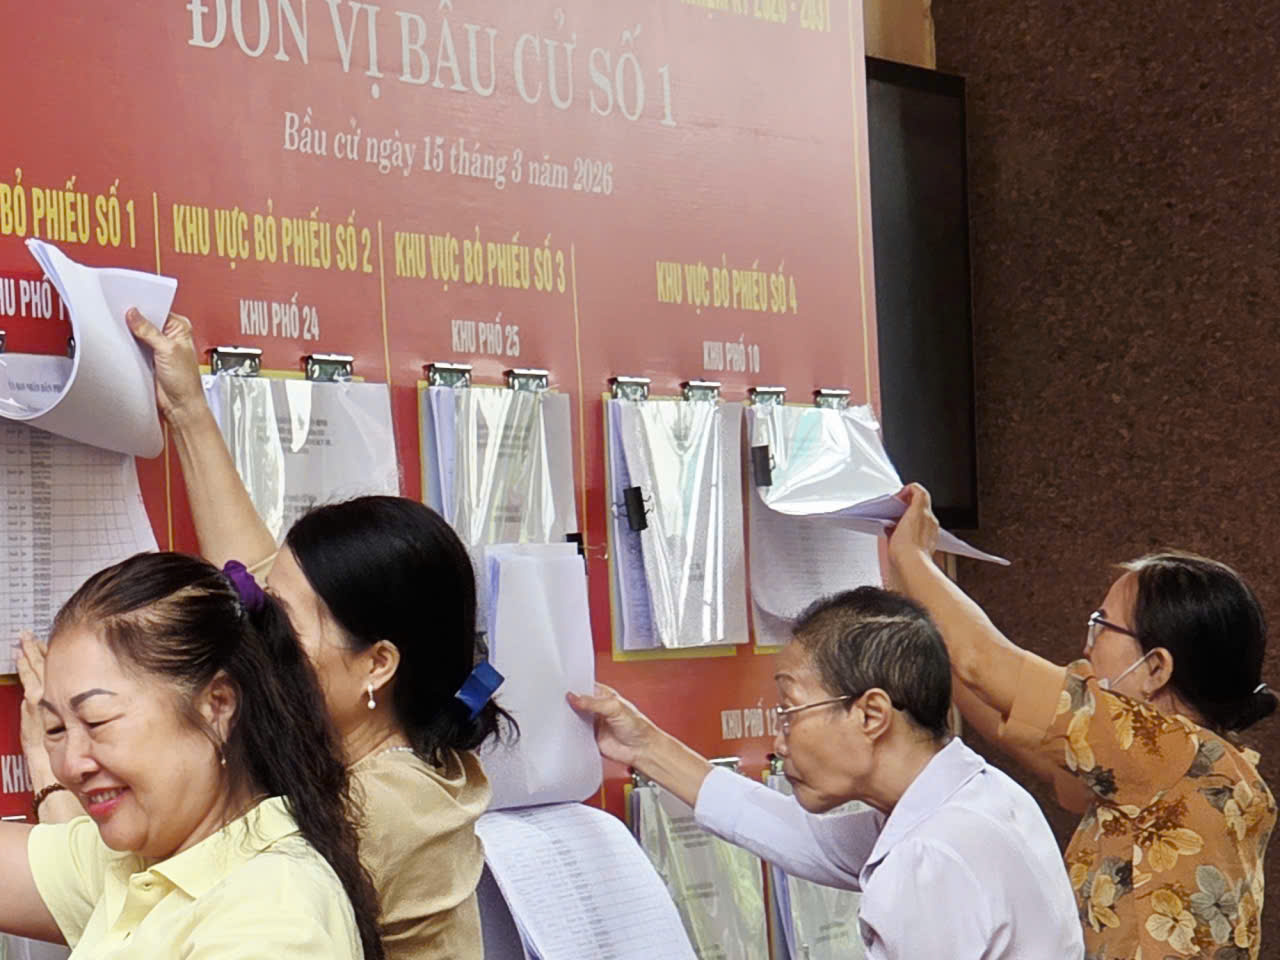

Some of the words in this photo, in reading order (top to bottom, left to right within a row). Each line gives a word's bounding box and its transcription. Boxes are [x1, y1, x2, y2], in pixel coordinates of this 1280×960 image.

[326, 0, 384, 99] VỊ
[513, 8, 576, 109] CỬ
[588, 24, 645, 120] SỐ
[657, 63, 676, 127] 1
[284, 107, 327, 155] Bầu
[334, 117, 361, 160] cử
[366, 129, 417, 176] ngày
[424, 136, 445, 172] 15
[450, 145, 509, 190] tháng
[512, 148, 523, 183] 3
[529, 152, 568, 189] năm
[573, 157, 614, 195] 2026
[0, 168, 26, 237] BỎ
[32, 176, 90, 244] PHIẾU
[95, 179, 121, 246] SỐ
[126, 200, 135, 248] 1
[173, 204, 210, 255] KHU
[214, 206, 249, 269] VỰC
[254, 199, 277, 262] BỎ
[281, 207, 331, 269] PHIẾU
[336, 209, 357, 271] SỐ
[361, 228, 372, 273] 2
[395, 232, 426, 278] KHU
[429, 232, 459, 291] VỰC
[463, 225, 483, 284] BỎ
[487, 232, 530, 289] PHIẾU
[534, 233, 553, 291] SỐ
[556, 250, 565, 293] 3
[656, 261, 683, 304] KHU
[684, 261, 710, 314] VỰC
[712, 254, 730, 307] BỎ
[732, 260, 767, 311] PHIẾU
[770, 261, 787, 313] SỐ
[789, 276, 797, 314] 4
[240, 299, 268, 336] KHU
[272, 292, 299, 338] PHỐ
[303, 305, 319, 340] 24
[452, 320, 476, 353] KHU
[478, 312, 502, 355] PHỐ
[505, 319, 520, 356] 25
[703, 341, 724, 371] KHU
[725, 335, 745, 372] PHỐ
[747, 344, 760, 373] 10
[721, 709, 742, 740] KHU
[744, 697, 764, 738] PHỐ
